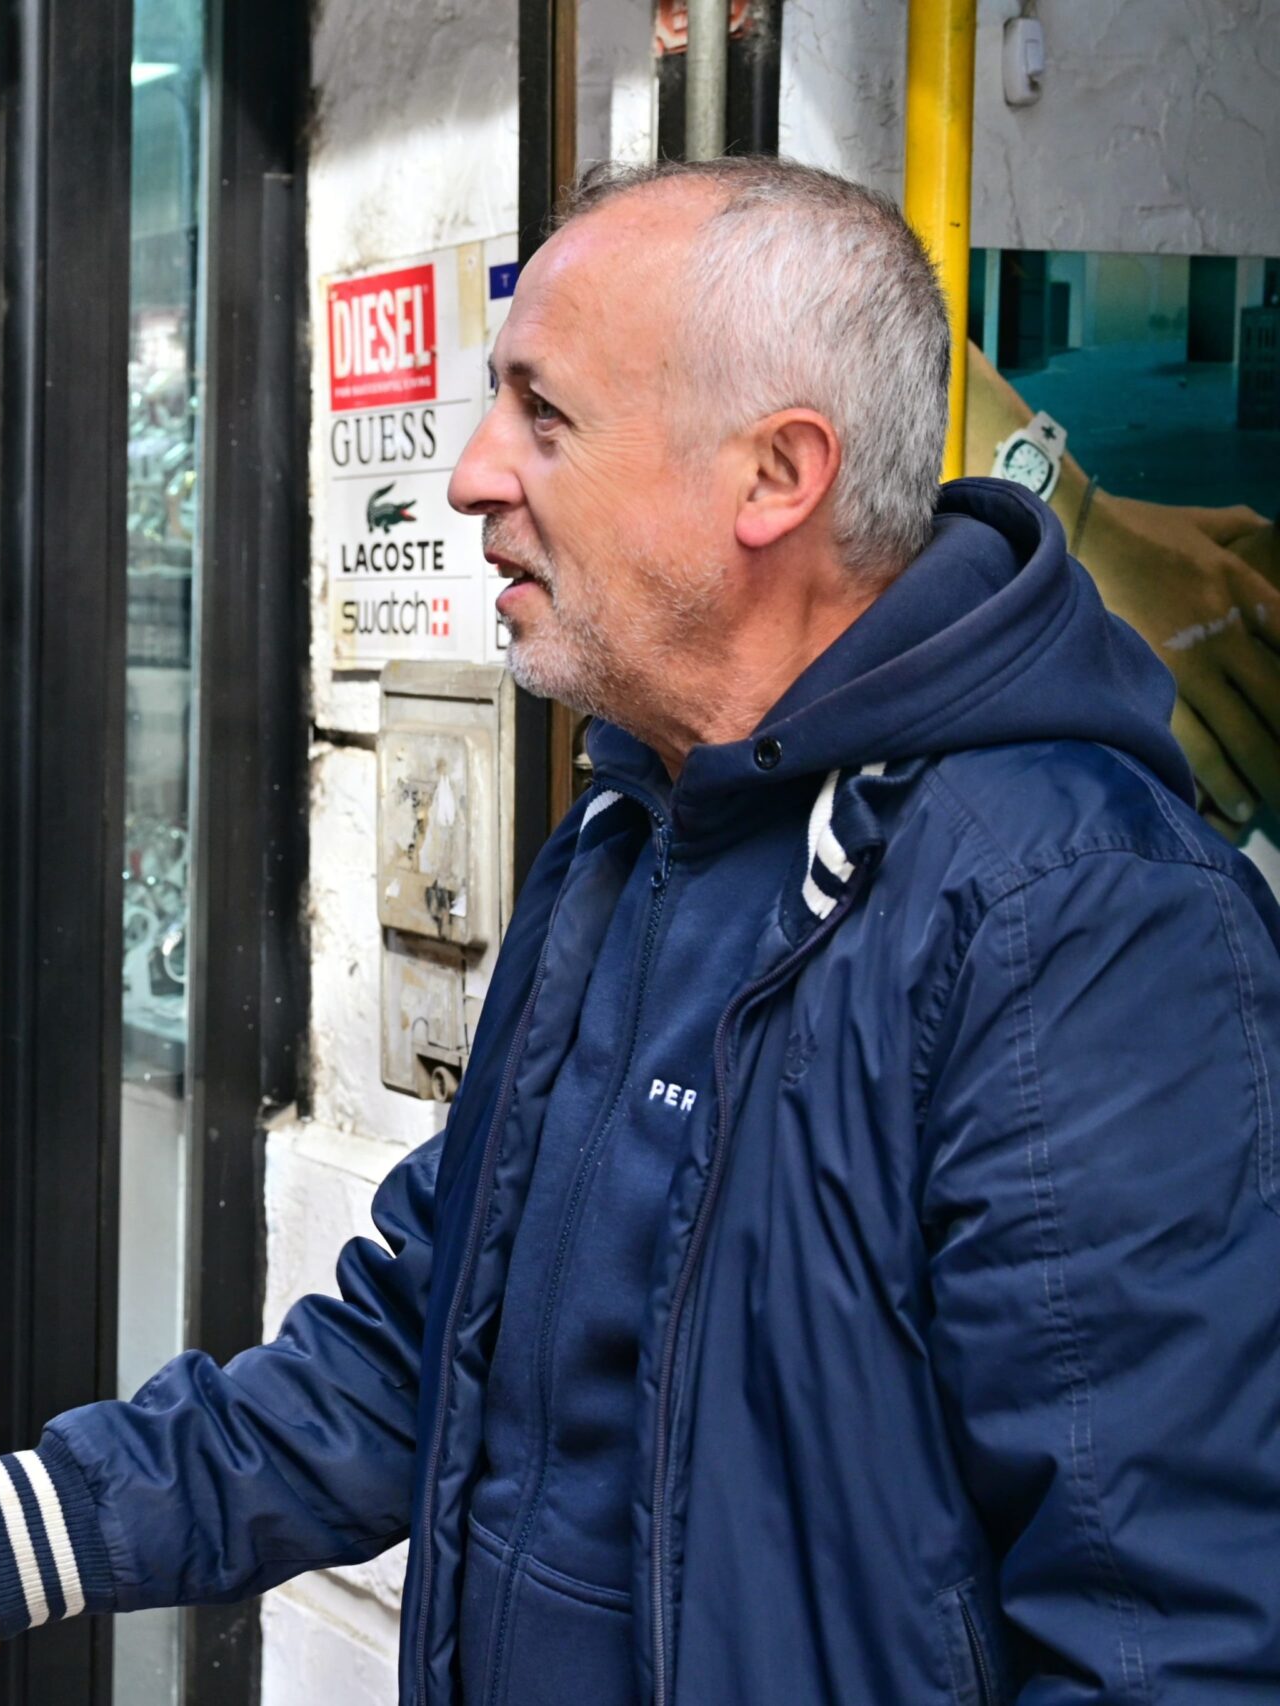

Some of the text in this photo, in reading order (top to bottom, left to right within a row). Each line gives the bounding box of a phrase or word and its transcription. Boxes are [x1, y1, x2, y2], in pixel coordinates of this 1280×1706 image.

[333, 284, 431, 379] DIESEL
[330, 409, 436, 467] GUESS
[341, 540, 444, 573] LACOSTE
[342, 591, 429, 635] swatch
[648, 1078, 697, 1112] PER
